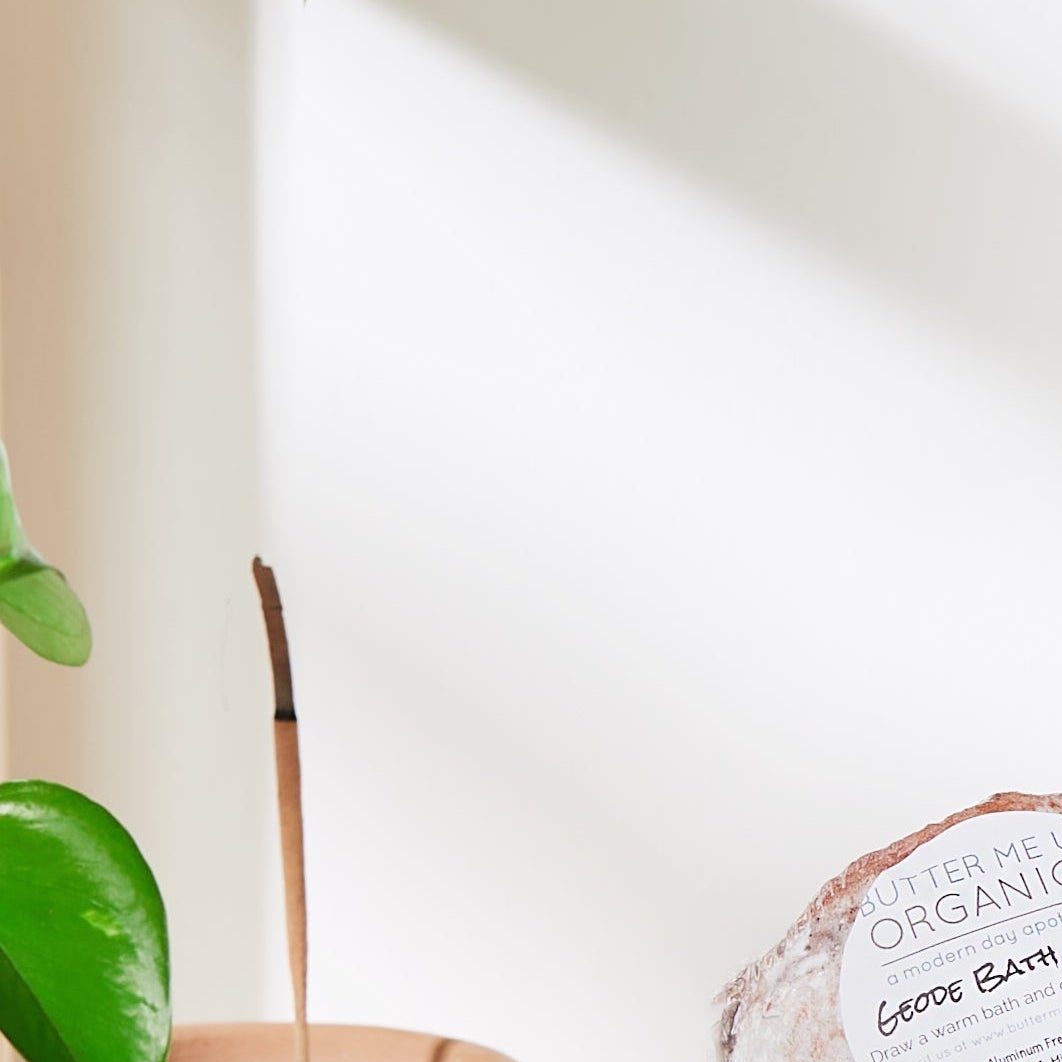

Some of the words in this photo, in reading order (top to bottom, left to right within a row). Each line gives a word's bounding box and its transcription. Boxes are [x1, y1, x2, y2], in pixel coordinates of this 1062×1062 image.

[860, 854, 986, 918] BUTTER
[993, 836, 1043, 868] ME
[886, 974, 899, 986] a
[903, 944, 977, 980] modern
[981, 929, 1018, 950] day
[877, 979, 964, 1037] GEODE
[972, 945, 1059, 994] BATH
[918, 1034, 929, 1046] a
[931, 1013, 980, 1039] warm
[981, 997, 1021, 1020] bath
[1023, 982, 1056, 1005] and
[936, 1049, 952, 1061] us
